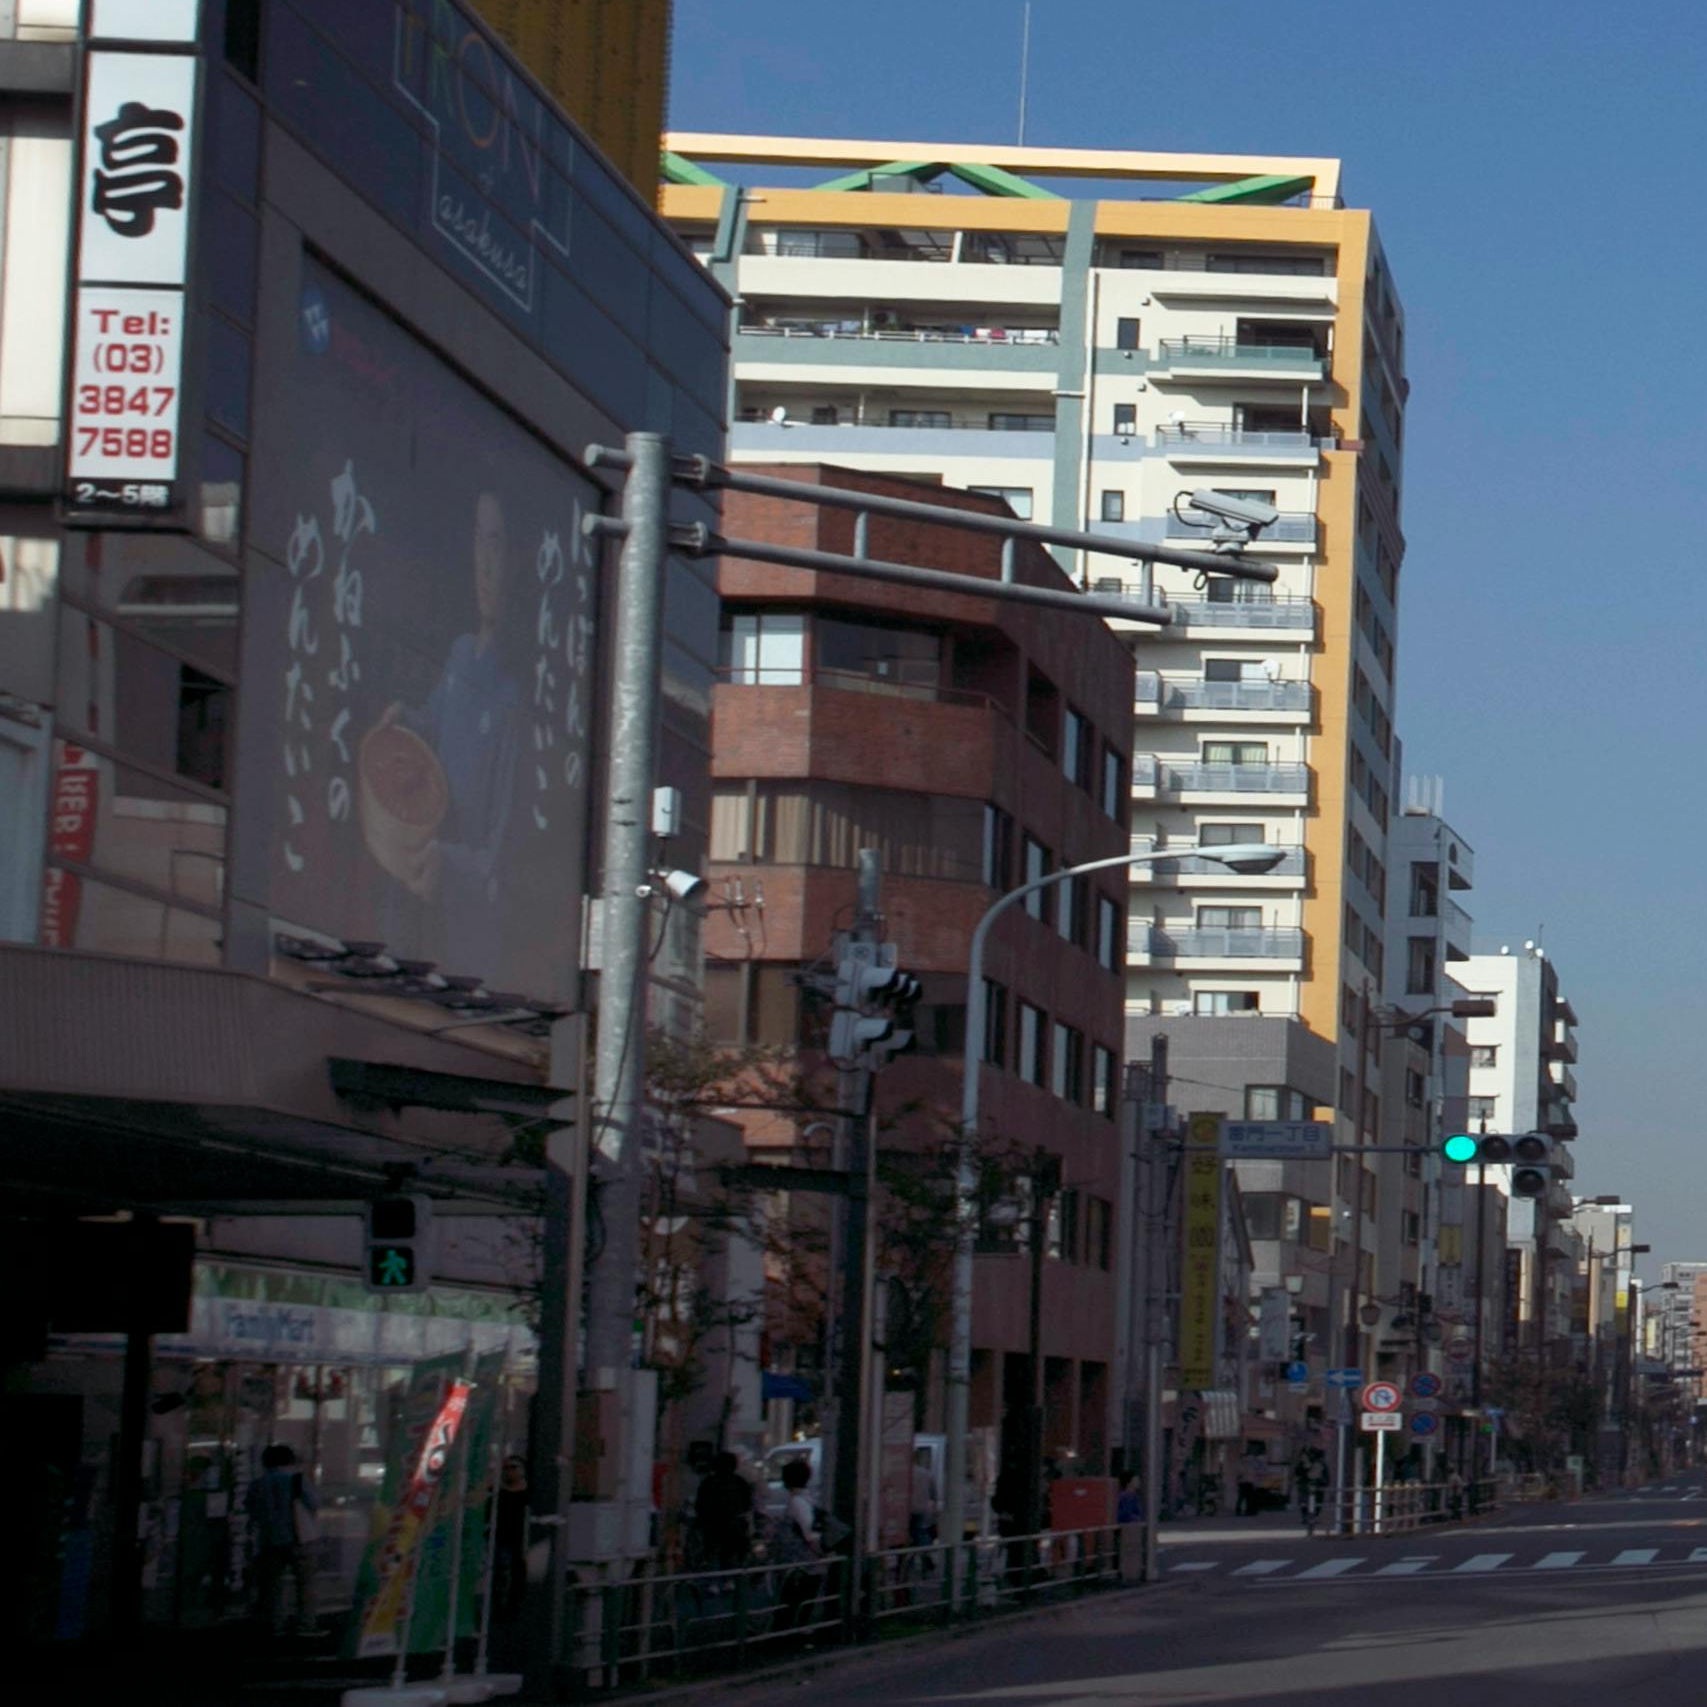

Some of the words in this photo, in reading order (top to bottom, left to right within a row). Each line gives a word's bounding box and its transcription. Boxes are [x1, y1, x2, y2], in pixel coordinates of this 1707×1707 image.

[90, 309, 170, 335] Tel:
[93, 343, 164, 374] (03)
[79, 385, 175, 417] 3847
[77, 426, 173, 460] 7588
[284, 510, 325, 873] めんたいこ
[531, 527, 566, 832] めんたいこ
